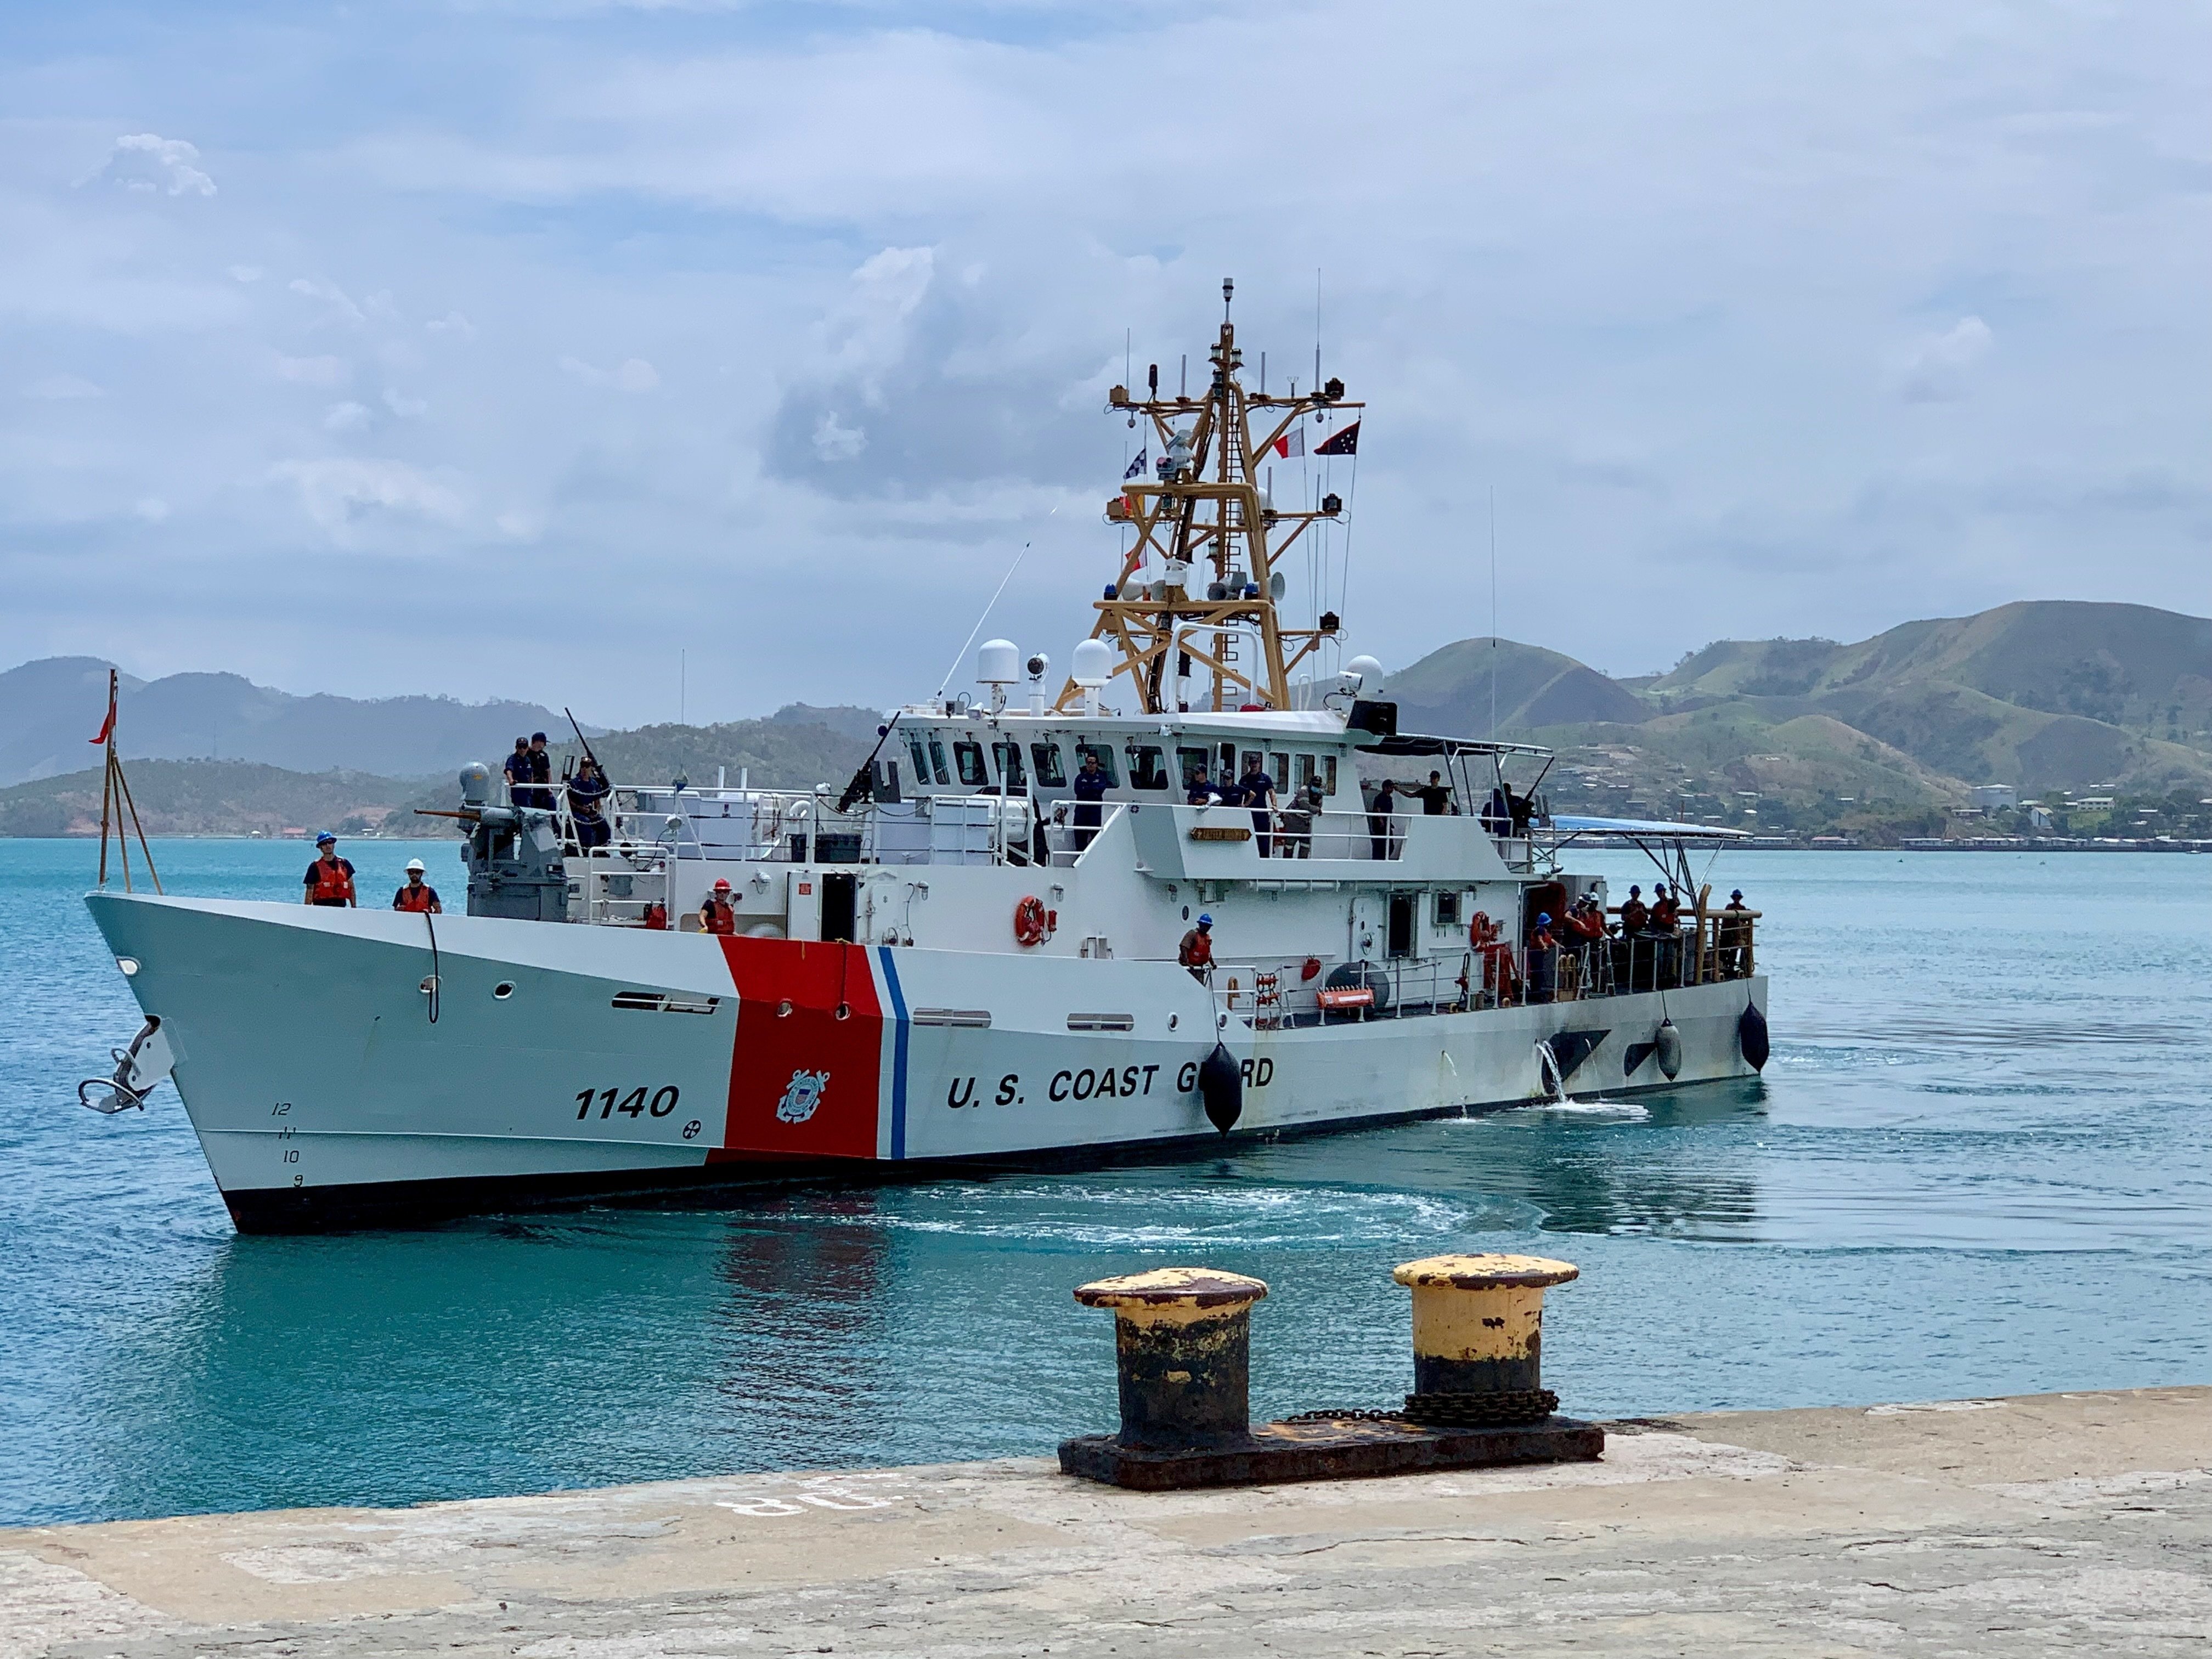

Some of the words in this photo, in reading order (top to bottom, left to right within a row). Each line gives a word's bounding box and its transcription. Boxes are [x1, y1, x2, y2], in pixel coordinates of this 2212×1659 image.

[947, 1077, 980, 1108] U.
[995, 1074, 1024, 1105] S.
[1048, 1065, 1160, 1102] COAST
[1177, 1058, 1273, 1092] GRD
[272, 1103, 291, 1115] 12
[575, 1085, 680, 1120] 1140
[284, 1150, 300, 1164] 10
[294, 1175, 303, 1187] 9
